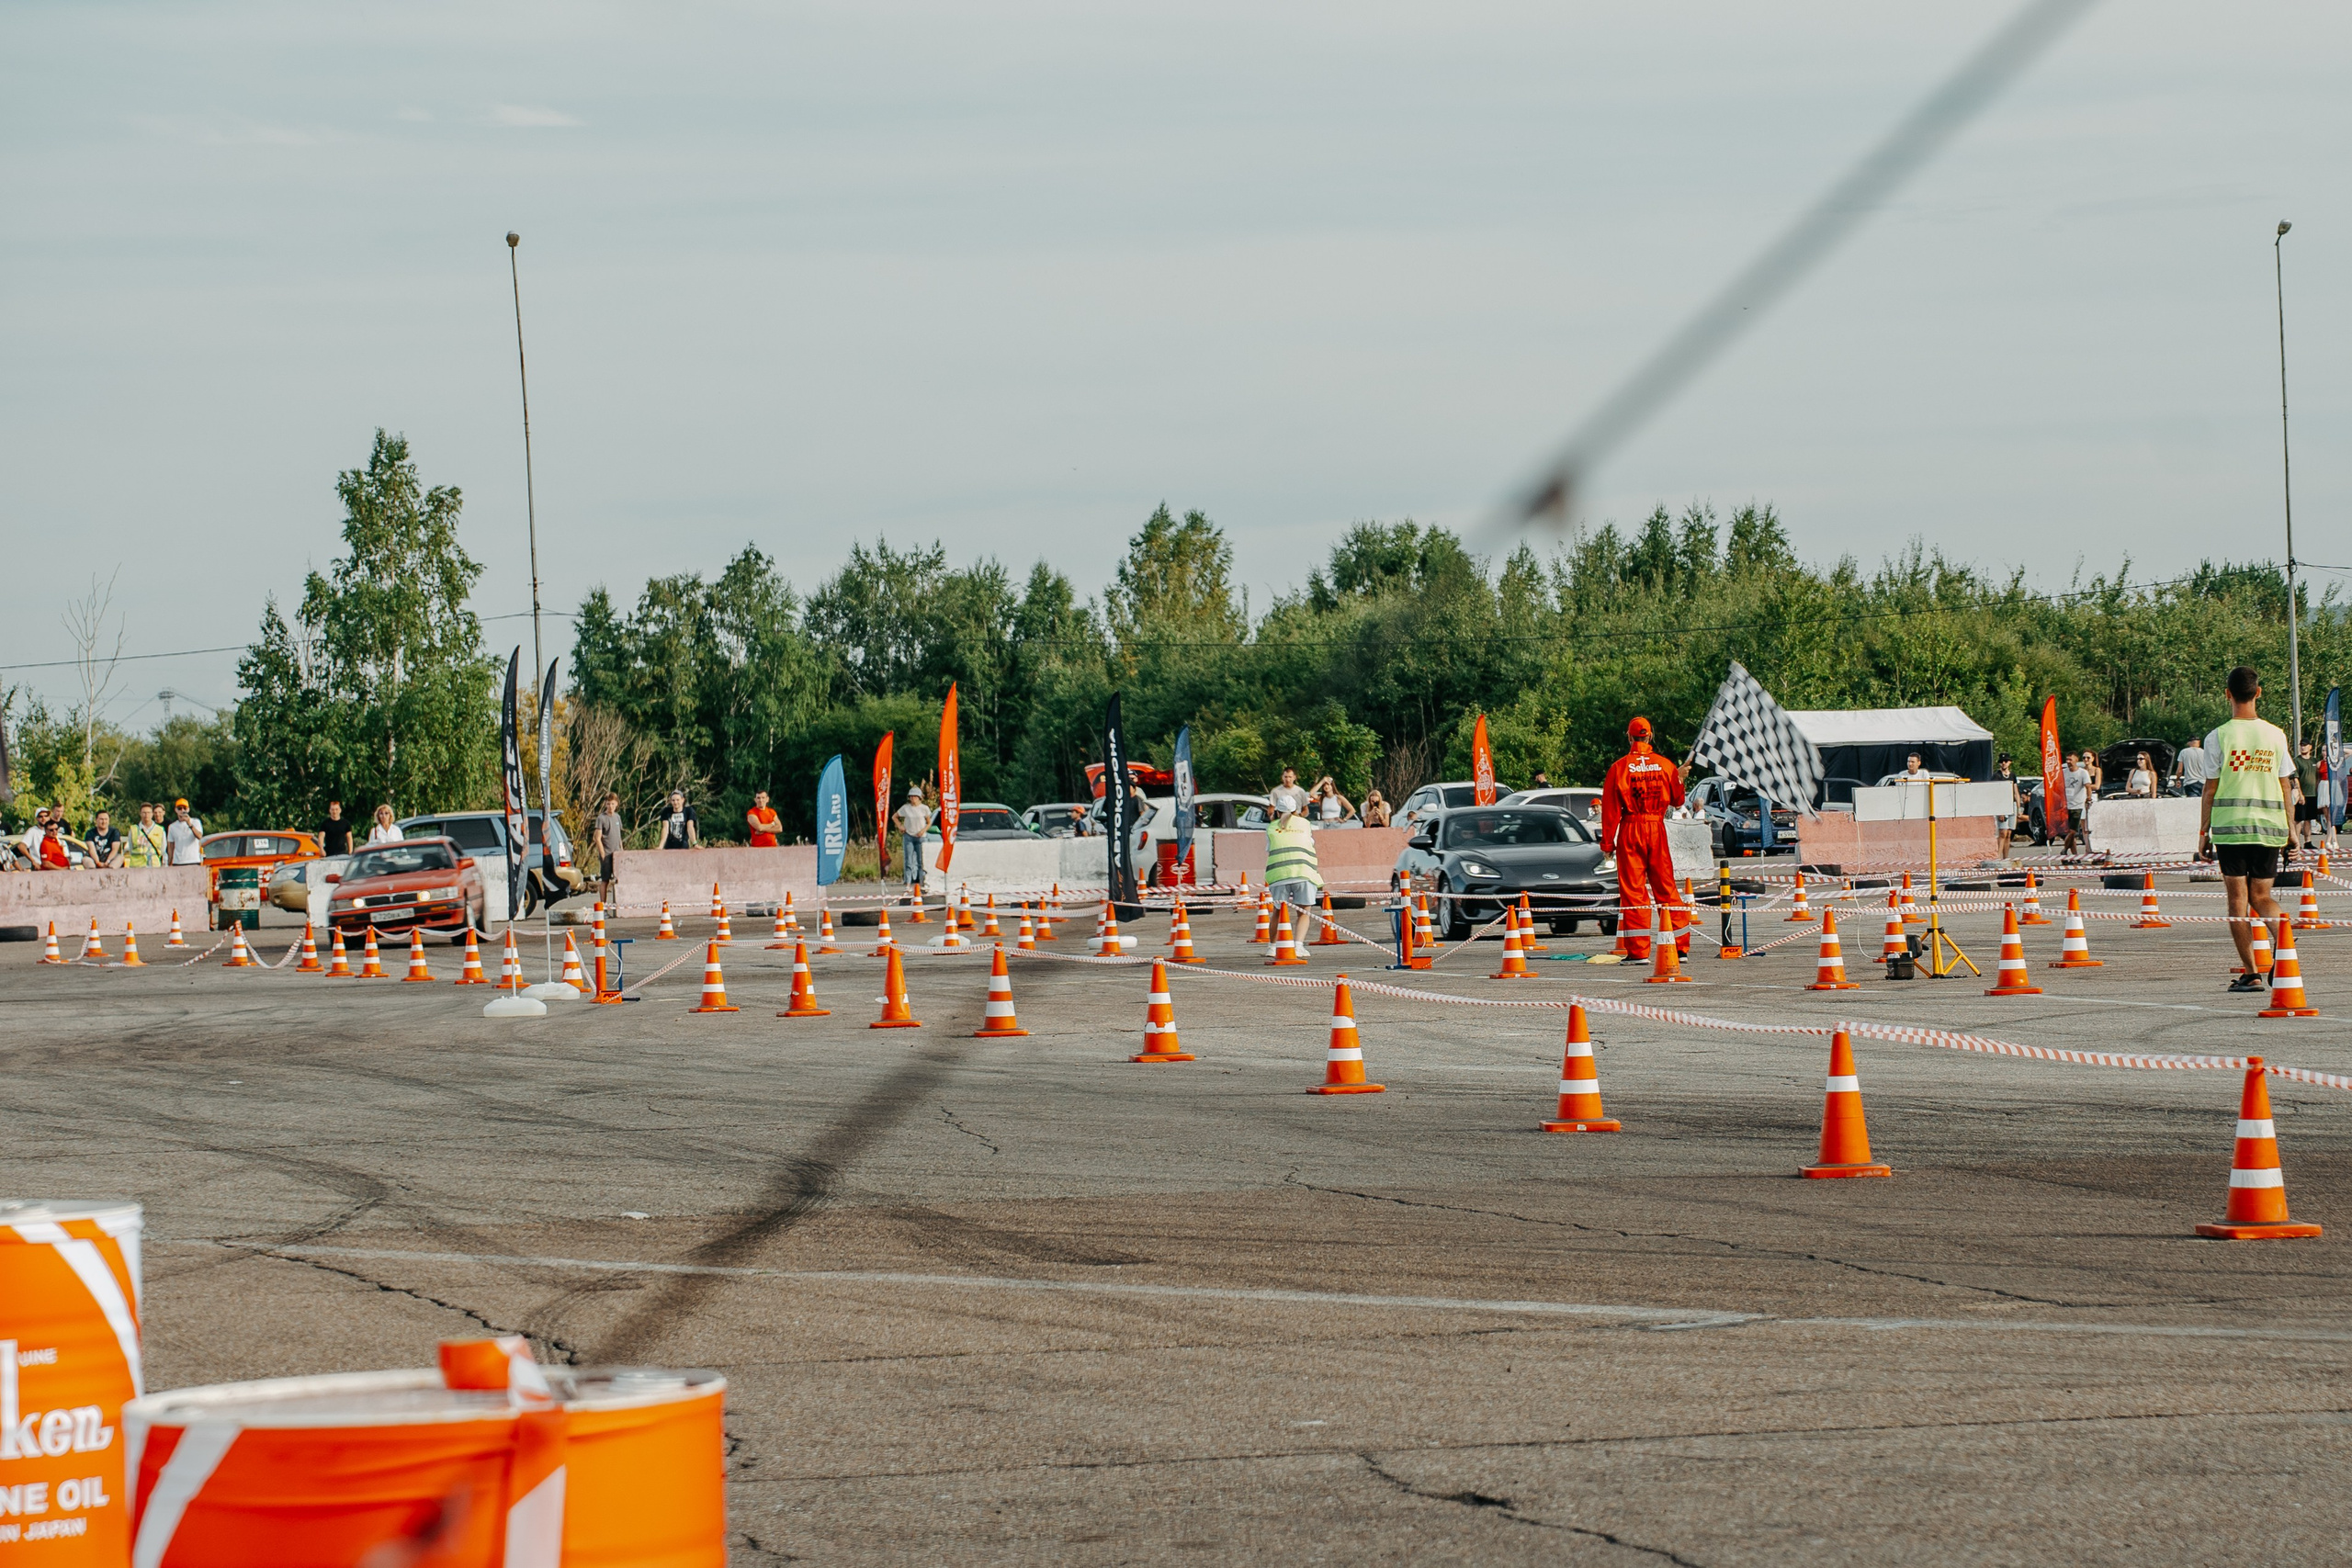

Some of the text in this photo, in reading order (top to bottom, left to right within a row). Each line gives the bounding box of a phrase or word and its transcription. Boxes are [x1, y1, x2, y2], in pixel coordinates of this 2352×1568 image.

[1628, 756, 1662, 773] Seiken
[1108, 728, 1125, 868] АВТОКОРОНА
[824, 793, 843, 855] IRK.RU
[57, 1476, 109, 1511] OIL
[23, 1517, 87, 1541] JAPAN
